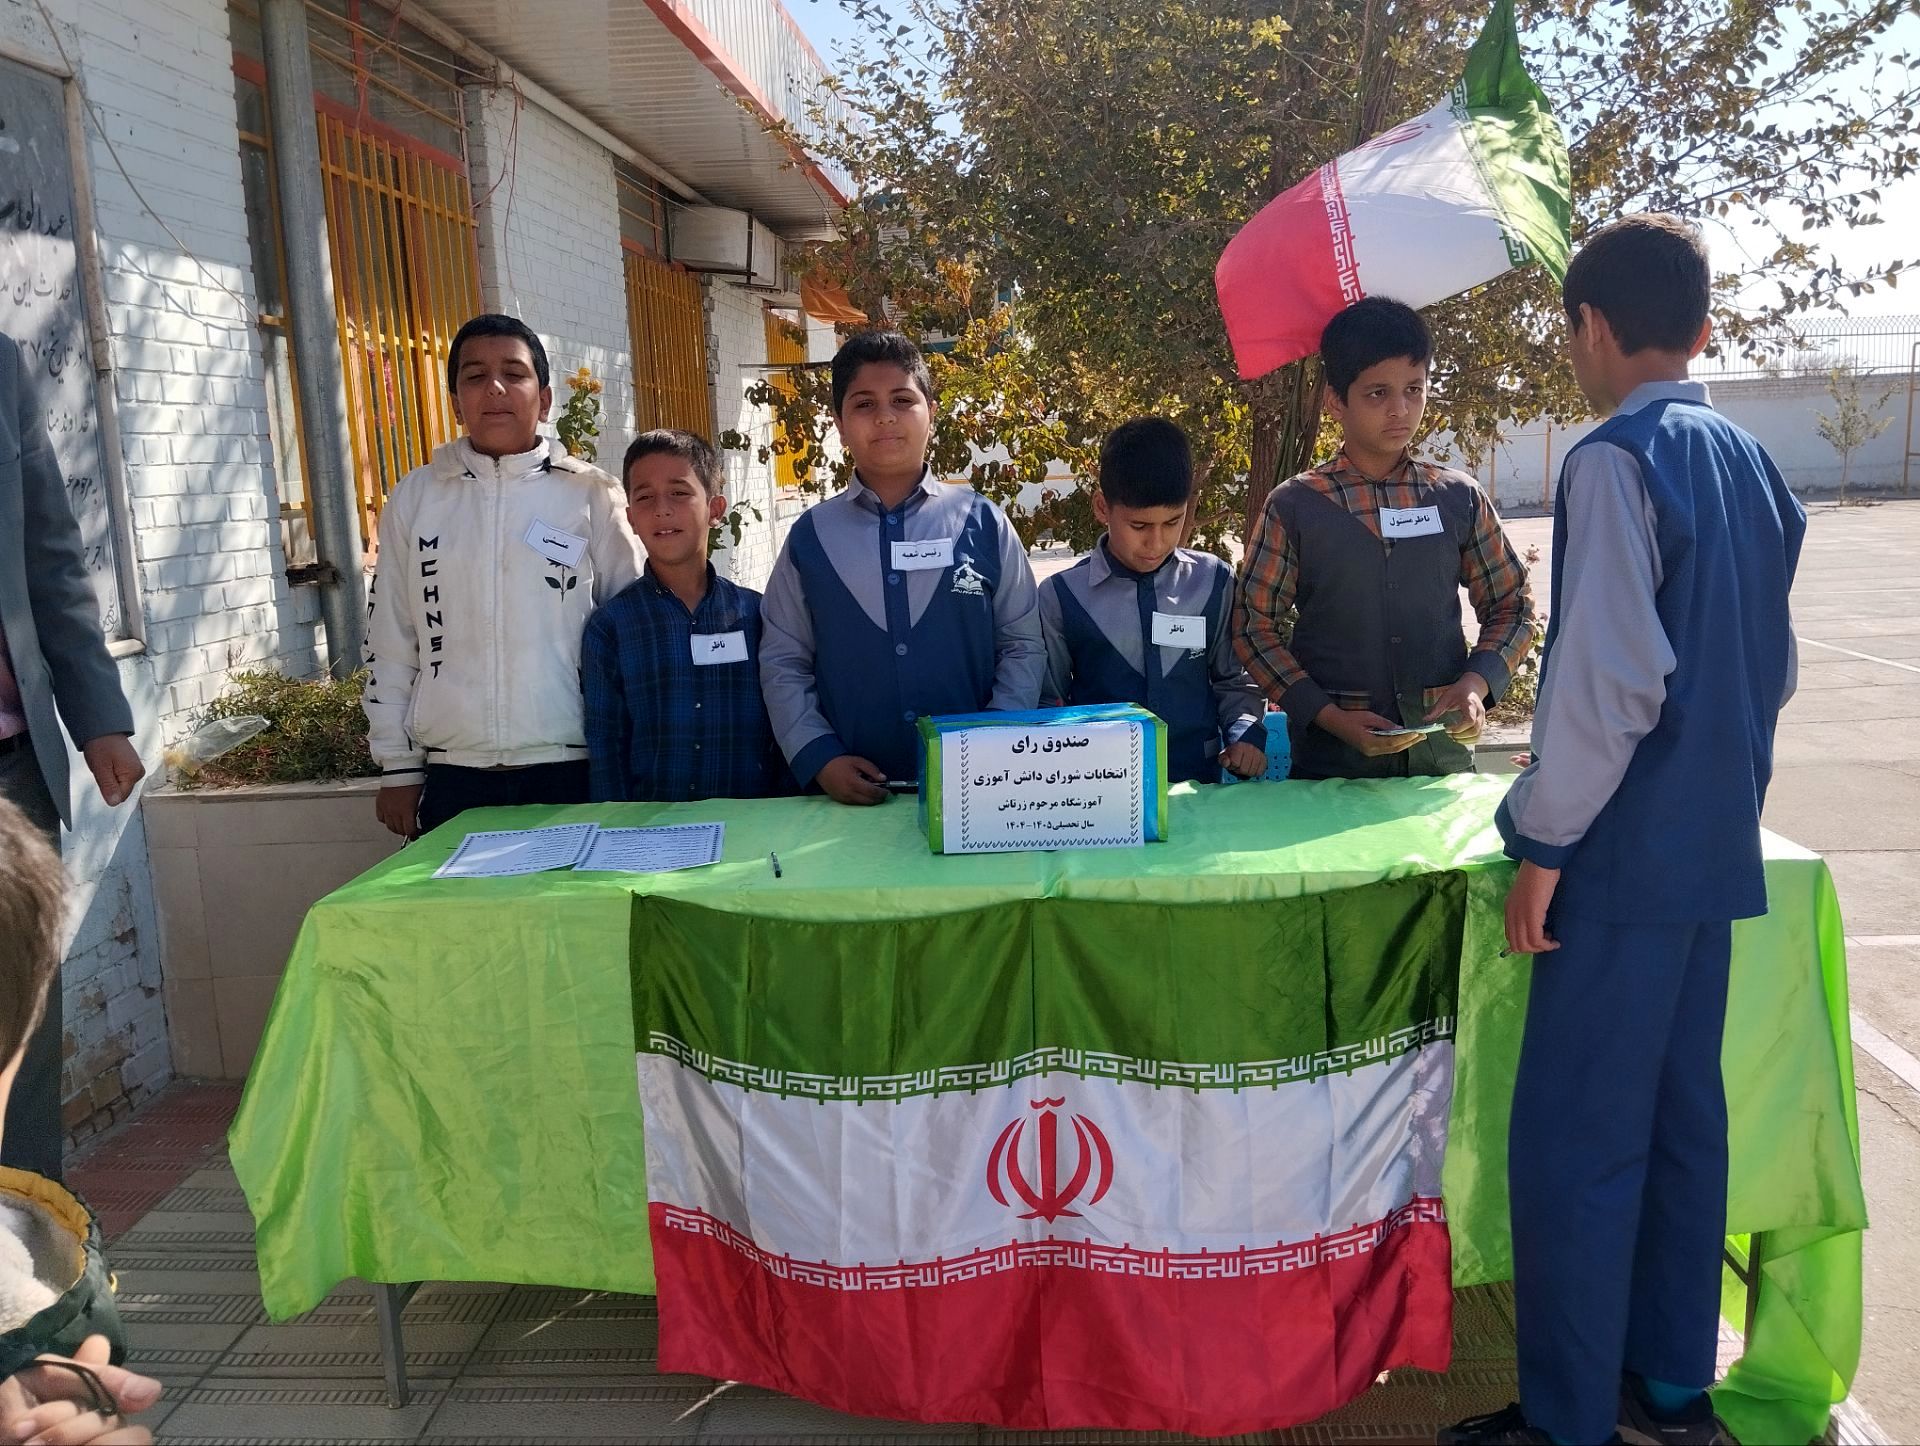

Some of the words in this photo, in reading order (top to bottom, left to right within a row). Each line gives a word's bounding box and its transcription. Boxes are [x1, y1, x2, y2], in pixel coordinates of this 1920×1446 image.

[1413, 514, 1430, 526] ناظر
[1169, 624, 1185, 635] ناظر
[711, 639, 726, 652] ناظر
[1011, 735, 1038, 753] رای
[1042, 735, 1090, 753] صندوق
[973, 769, 1010, 786] آموزی
[1013, 770, 1043, 785] دانش
[1045, 769, 1081, 784] شورای
[1083, 768, 1127, 783] انتخابات
[1029, 800, 1059, 810] مرحوم
[1061, 795, 1103, 809] آموزشگاه
[1081, 820, 1095, 830] سال
